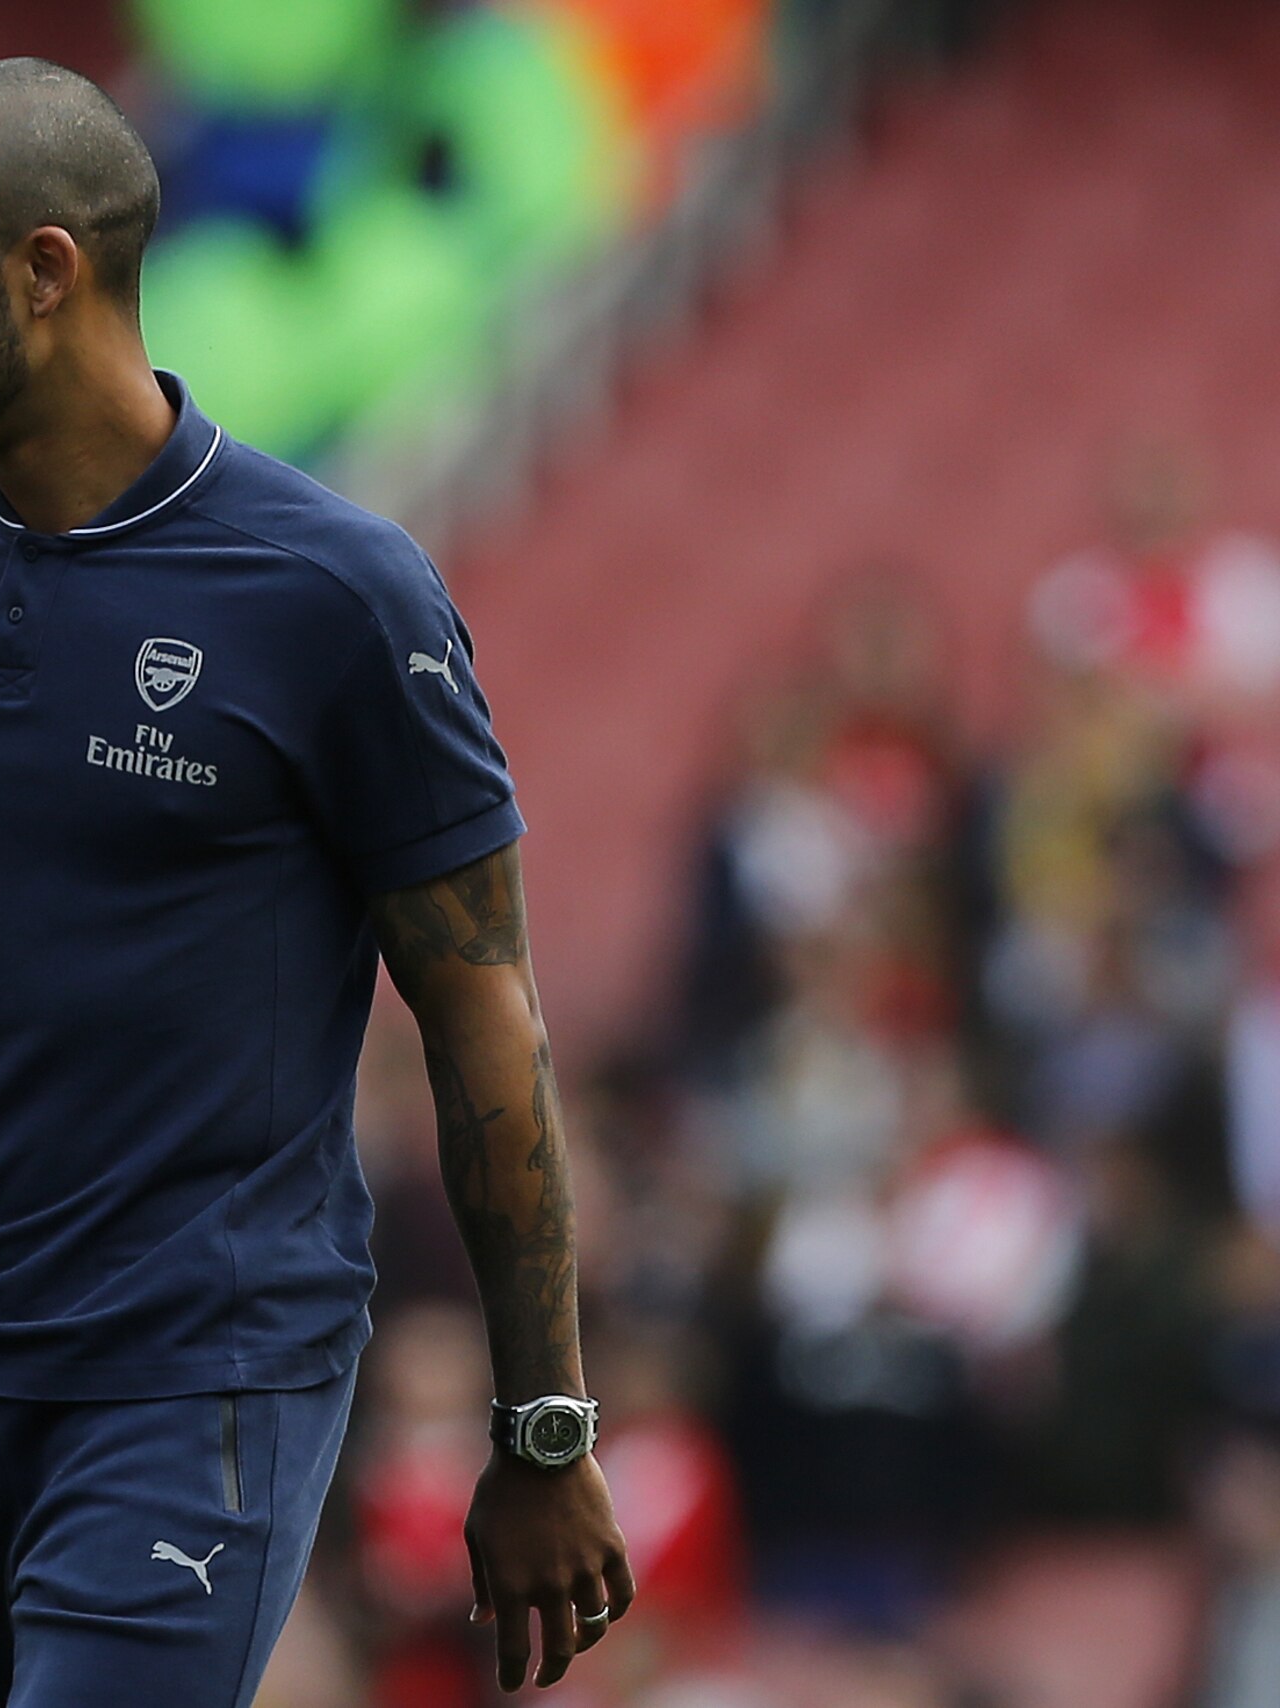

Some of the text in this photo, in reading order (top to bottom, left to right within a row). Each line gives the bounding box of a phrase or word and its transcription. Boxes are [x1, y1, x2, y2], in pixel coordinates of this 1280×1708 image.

[146, 649, 193, 668] Arsenal
[135, 723, 173, 753] Fly
[87, 735, 218, 786] Emirates
